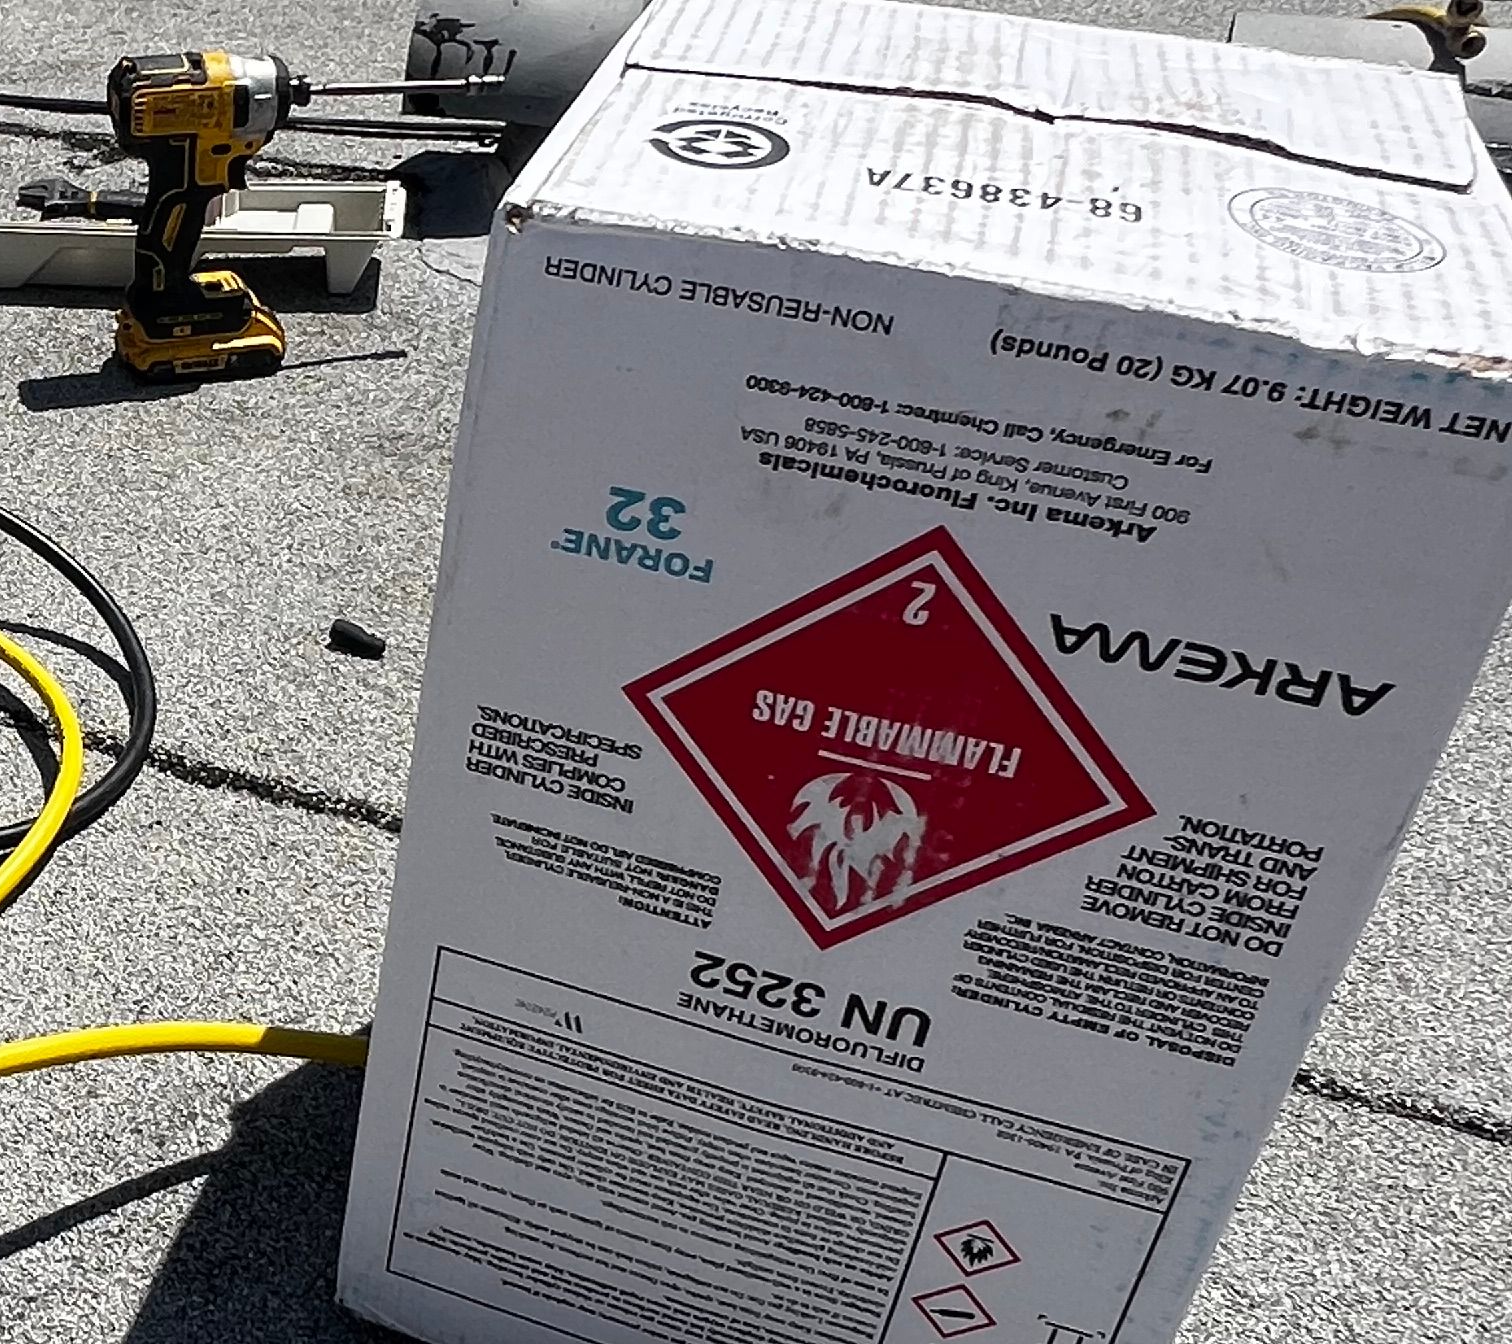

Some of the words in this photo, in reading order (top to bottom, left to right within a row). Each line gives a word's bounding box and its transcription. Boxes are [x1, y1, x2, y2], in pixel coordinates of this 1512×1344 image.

[864, 165, 1145, 224] 68-438637A
[543, 255, 672, 296] CYLINDER
[678, 279, 894, 335] NON-REUSABLE
[989, 327, 1109, 372] Pounds)
[1115, 354, 1164, 382] (20
[1169, 363, 1217, 392] KG
[745, 374, 889, 414] 1-800-424-9300
[1219, 374, 1288, 402] 9.07
[894, 402, 999, 435] Chemtrec:
[1294, 385, 1431, 429] WEIGHT:
[739, 424, 780, 447] USA
[803, 416, 946, 457] 1-800-245-5858
[1001, 421, 1044, 443] Call
[1439, 411, 1512, 443] NET
[783, 434, 838, 458] 19406
[843, 445, 871, 465] PA
[953, 445, 1030, 474] Service:
[1049, 426, 1171, 466] Emergency,
[875, 449, 948, 480] Prussia,
[948, 466, 972, 482] of
[1031, 460, 1129, 491] Customer
[1173, 453, 1213, 474] For
[758, 451, 978, 510] Fluorochemicals
[974, 468, 1019, 494] King
[1024, 477, 1102, 507] Avenue,
[605, 485, 686, 540] 32
[986, 494, 1038, 522] Inc.
[1103, 494, 1148, 518] First
[1150, 504, 1191, 525] 900
[1045, 506, 1157, 543] Arkema
[901, 580, 936, 626] 2
[1050, 613, 1398, 715] ARKEMA
[751, 689, 815, 732] GAS
[470, 721, 599, 768] PRESCRIBED
[476, 704, 642, 760] SPECIFICATIONS.
[821, 706, 1021, 777] FLAMMABLE
[467, 738, 519, 766] WITH
[465, 755, 565, 795] CYLINDER
[520, 753, 626, 793] COMPLIES
[565, 782, 634, 814] INSIDE
[1162, 834, 1254, 868] TRANS-
[1178, 814, 1324, 863] PORTATION.
[1115, 862, 1220, 900] CARTON
[1120, 844, 1251, 888] SHIPMENT
[1257, 855, 1318, 882] AND
[1084, 874, 1206, 918] CYLINDER
[1221, 887, 1300, 920] FROM
[1251, 874, 1308, 902] FOR
[1079, 893, 1185, 933] REMOVE
[1206, 905, 1292, 939] INSIDE
[1183, 921, 1241, 947] NOT
[1242, 934, 1284, 958] DO
[689, 950, 825, 1018] 3252
[950, 984, 1044, 1017] CYLINDER:
[676, 991, 925, 1073] DIFLUOROMETHANE
[840, 992, 931, 1048] UN
[1045, 1010, 1110, 1035] EMPTY
[1112, 1027, 1140, 1042] OF
[1144, 1034, 1236, 1067] DISPOSAL
